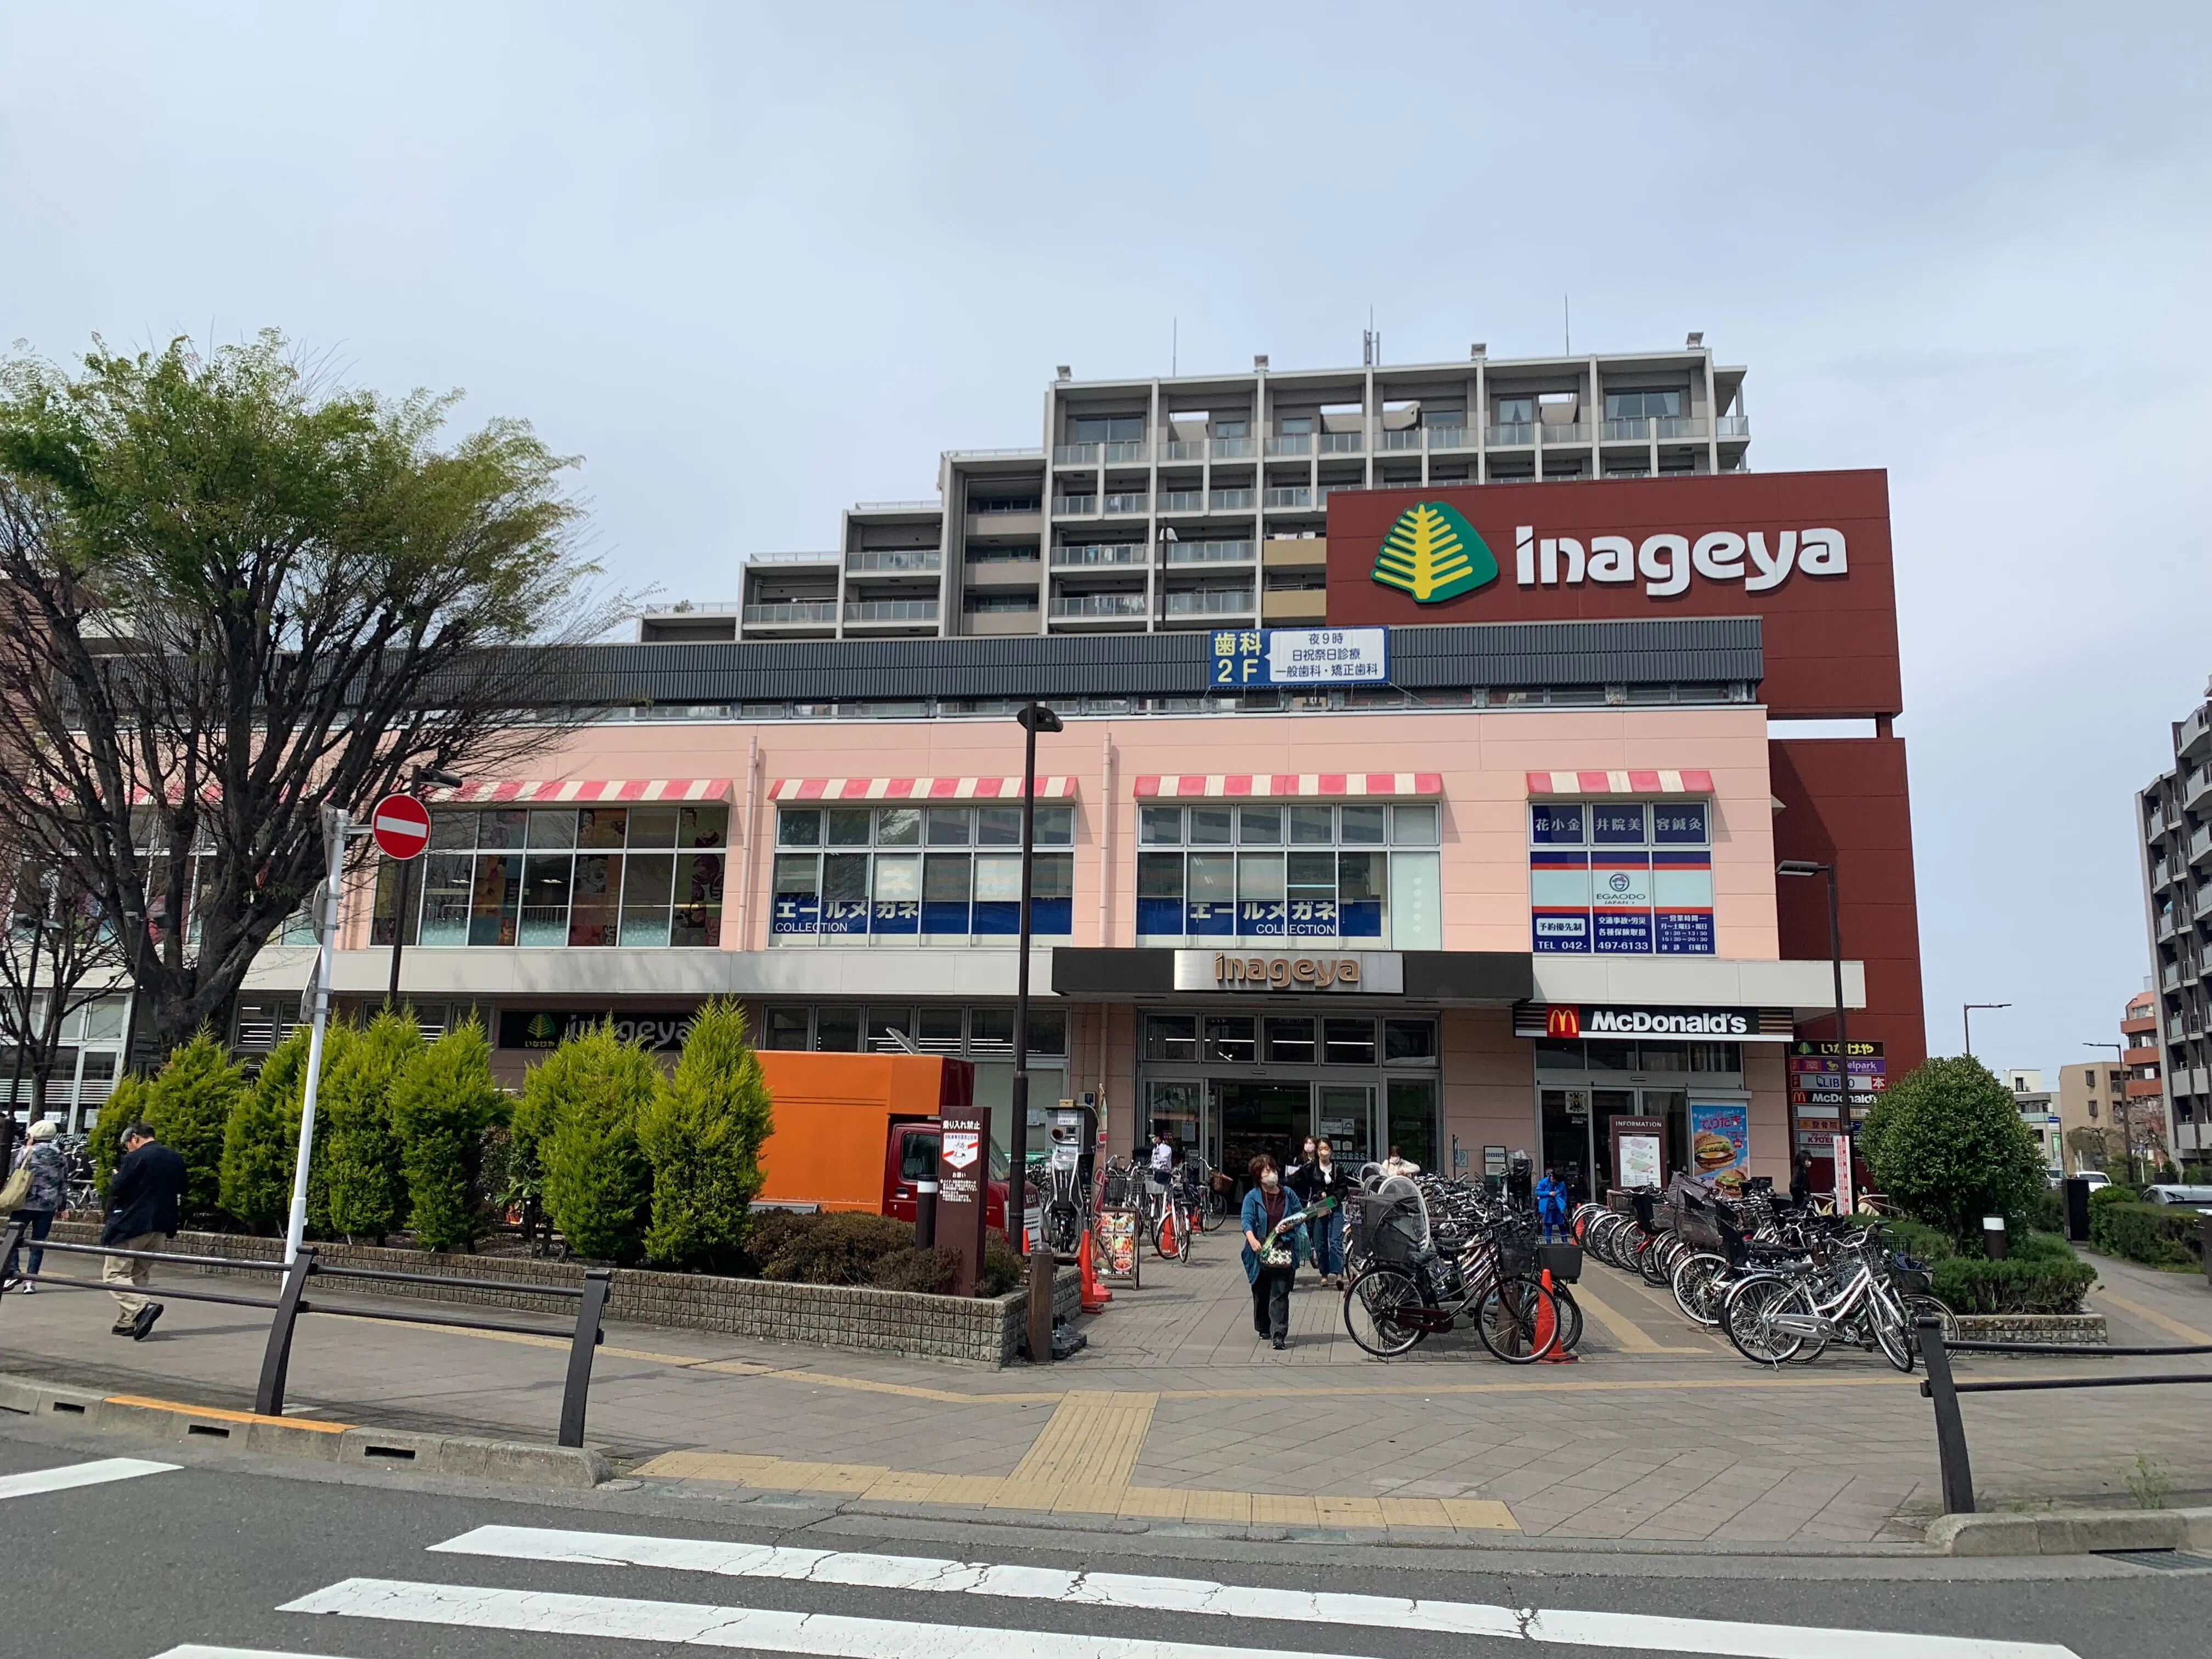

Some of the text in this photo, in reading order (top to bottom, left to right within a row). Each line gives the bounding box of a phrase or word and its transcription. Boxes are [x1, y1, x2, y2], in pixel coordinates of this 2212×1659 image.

[1516, 525, 1848, 596] inageya
[1214, 632, 1262, 657] 歯科
[1308, 633, 1344, 645] 夜9時
[1293, 648, 1361, 662] 日祝祭日診療
[1217, 658, 1259, 683] 2F
[1275, 663, 1378, 678] 一般歯科・矯正歯科
[775, 922, 848, 932] COLLECTION
[1256, 924, 1335, 934] COLLECTION
[1539, 923, 1582, 931] 予約優先制
[1599, 928, 1646, 936] 各種保険取扱
[1538, 941, 1649, 950] TEL 042- 497-6133
[1215, 952, 1359, 988] inageya
[1590, 1011, 1747, 1034] McDonald's
[1823, 1078, 1855, 1088] LIBO
[1872, 1077, 1886, 1089] 本
[943, 1120, 981, 1130] 乗り入れ禁止
